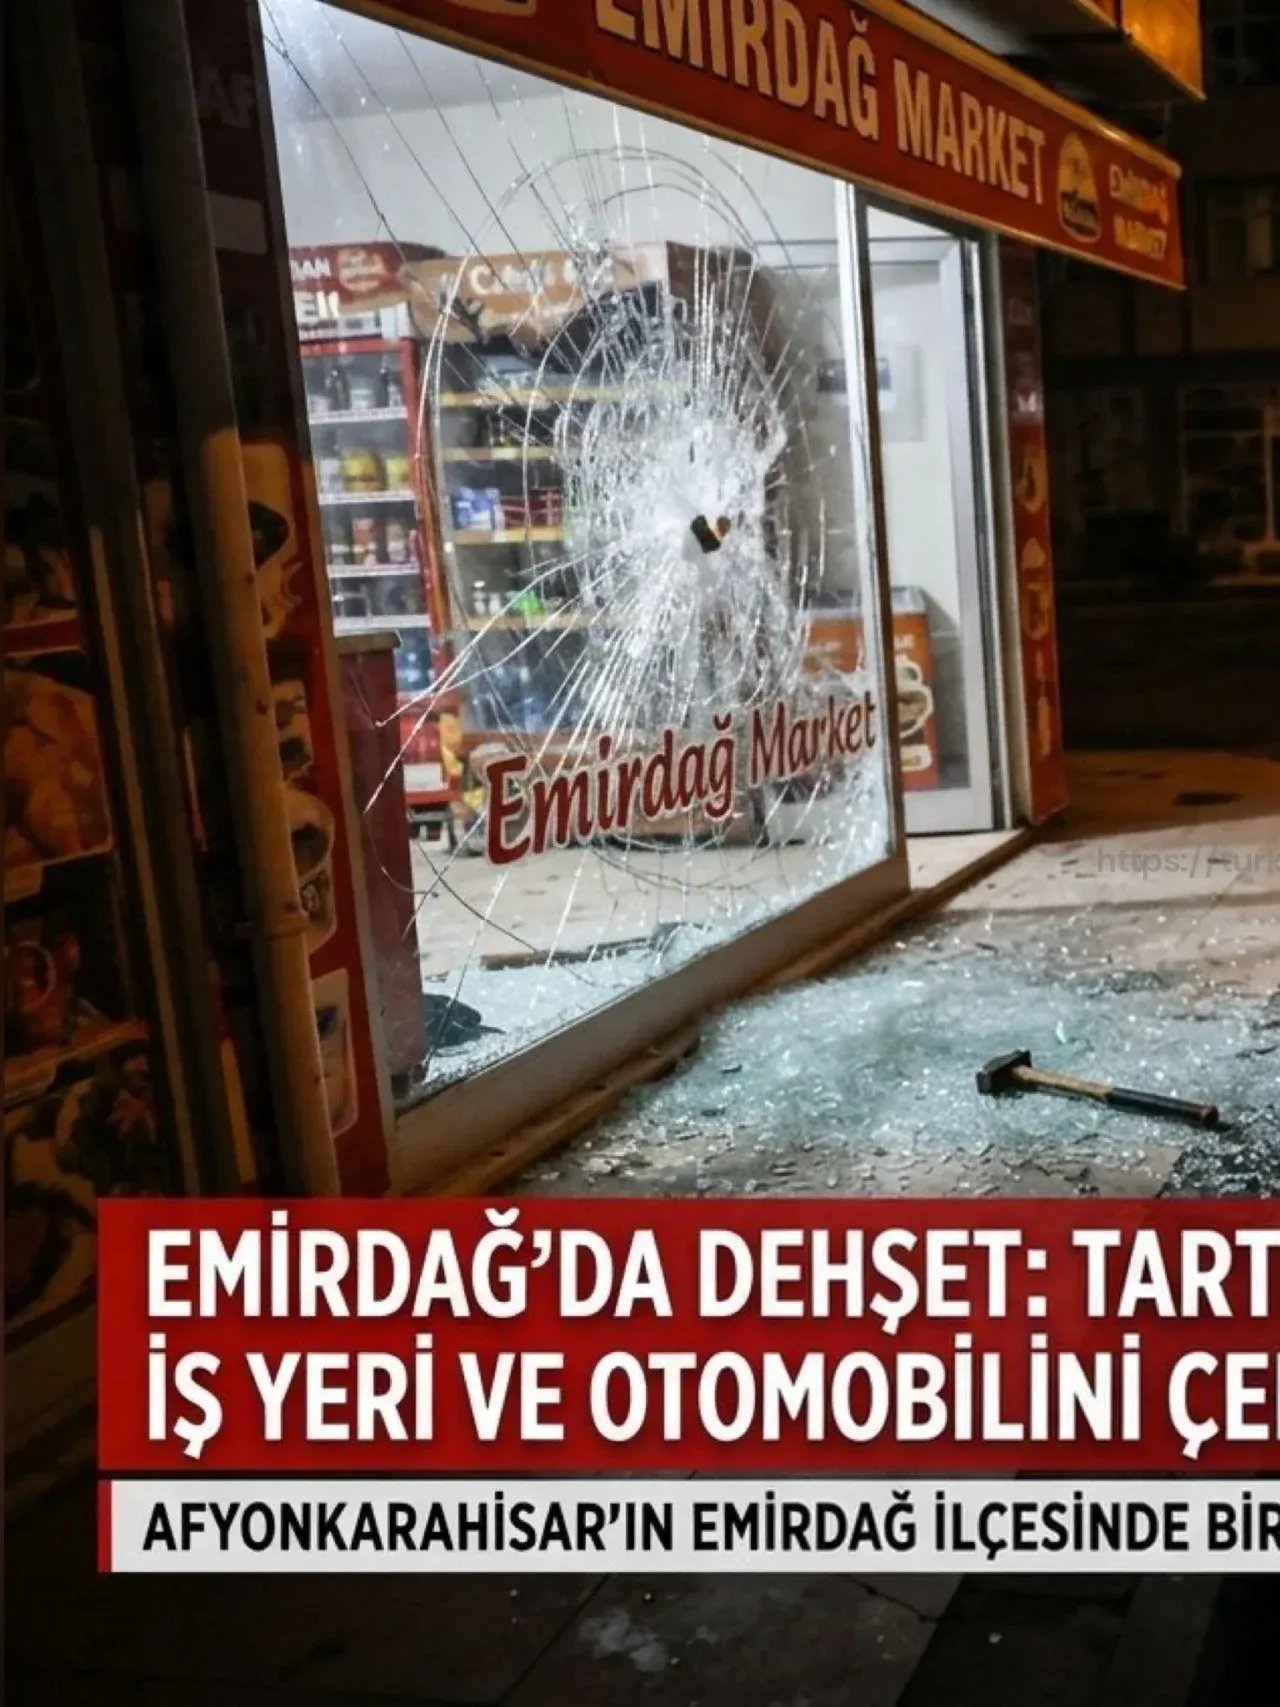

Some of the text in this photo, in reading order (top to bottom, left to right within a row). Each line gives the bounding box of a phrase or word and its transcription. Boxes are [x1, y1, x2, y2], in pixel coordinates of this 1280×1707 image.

[893, 57, 1047, 205] MARKET
[485, 691, 877, 866] Emirdağ Market
